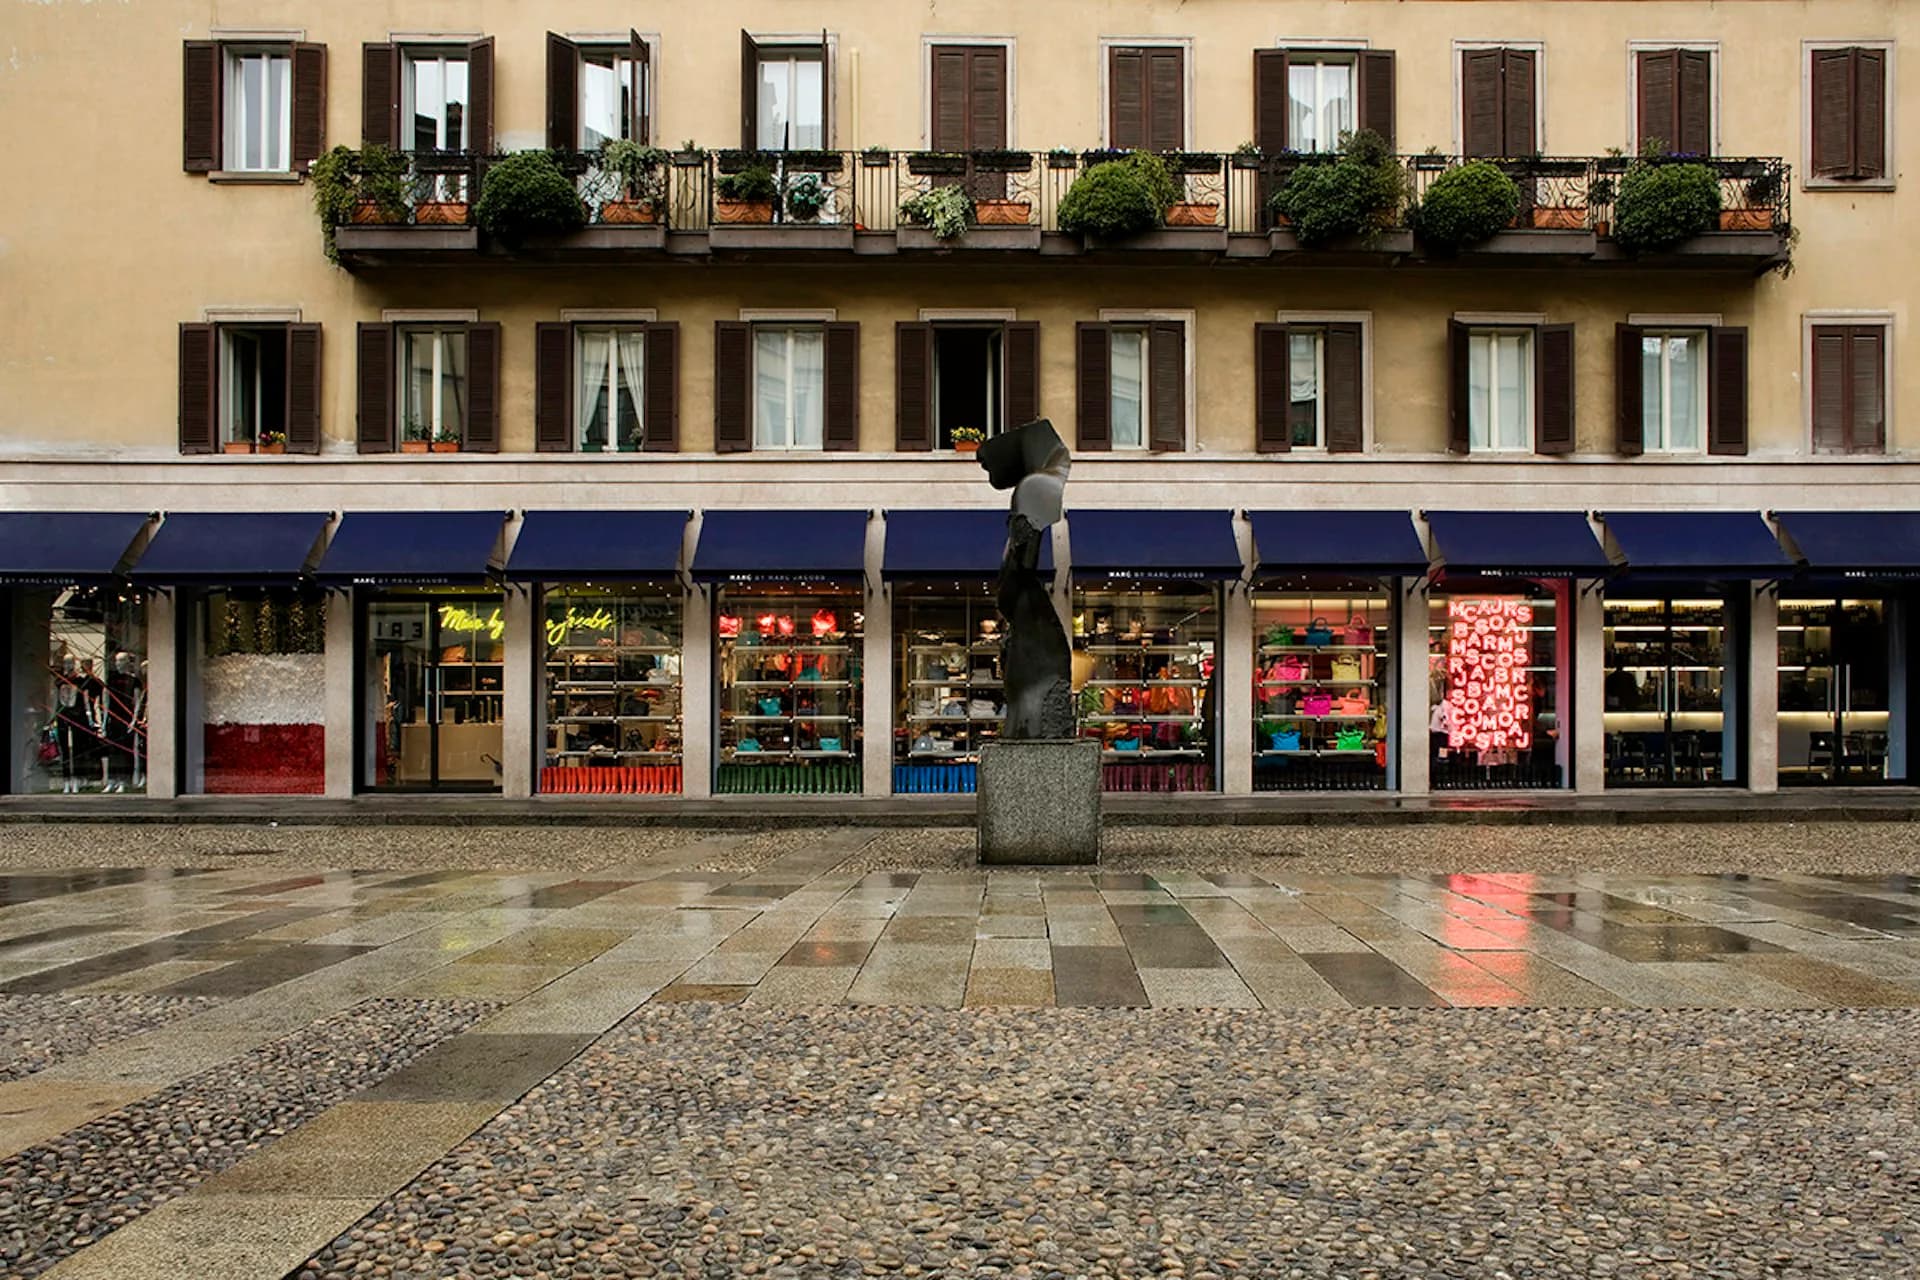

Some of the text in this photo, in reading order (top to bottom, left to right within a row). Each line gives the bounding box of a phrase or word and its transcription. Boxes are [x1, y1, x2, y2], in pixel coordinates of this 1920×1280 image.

[1108, 571, 1131, 579] MARC
[1481, 569, 1503, 577] MARC
[353, 576, 376, 585] MARC
[729, 574, 751, 582] MARC
